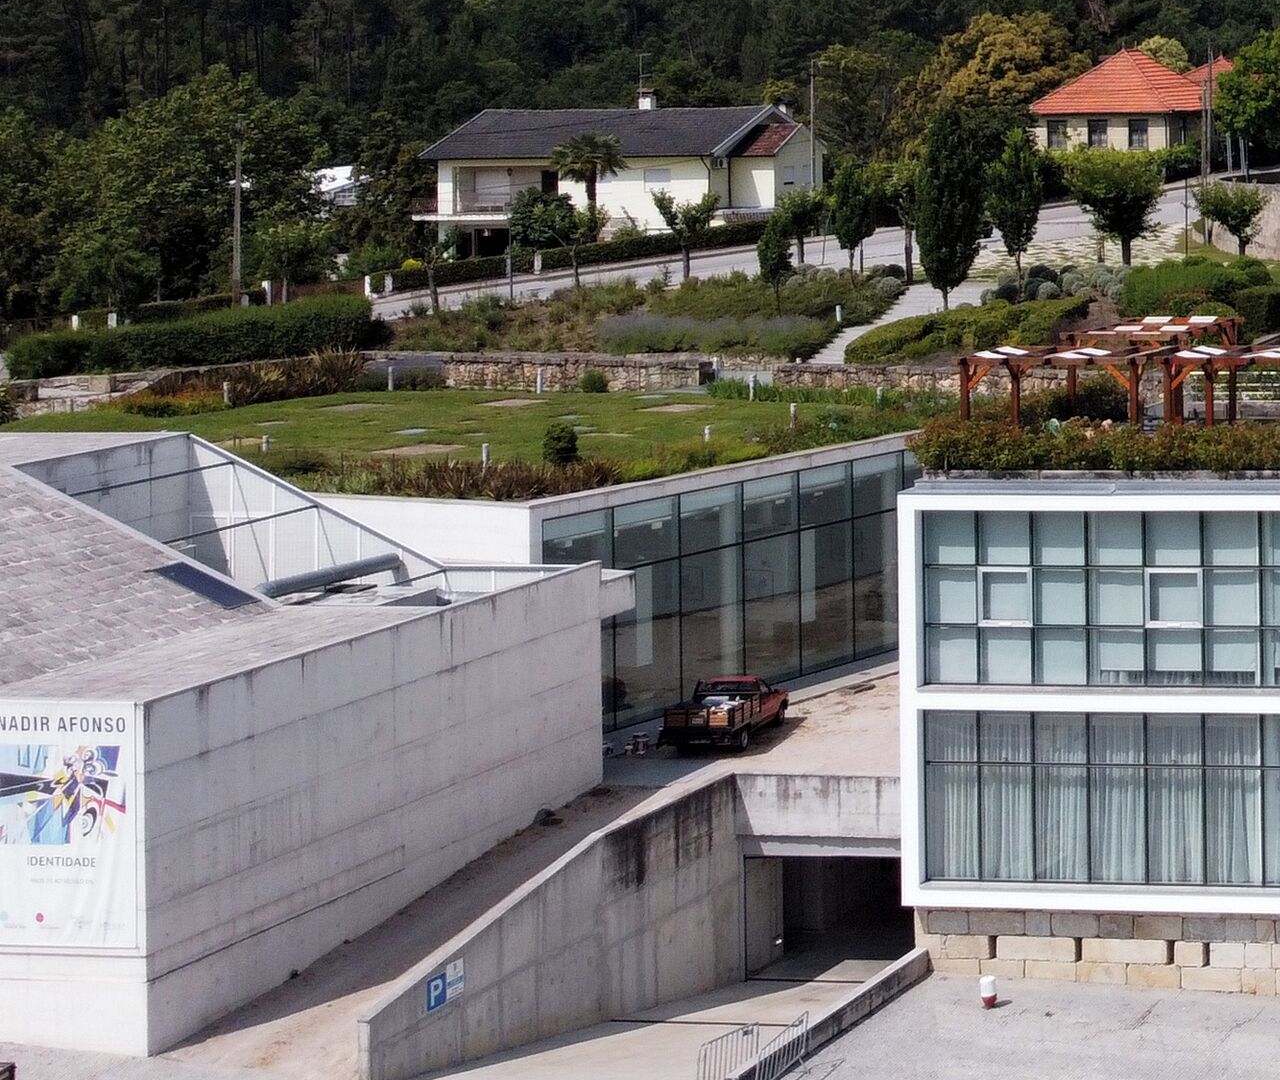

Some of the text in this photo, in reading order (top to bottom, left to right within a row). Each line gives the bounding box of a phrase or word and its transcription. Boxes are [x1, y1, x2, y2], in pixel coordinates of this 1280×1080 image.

[0, 716, 126, 732] NADIR AFONSO
[26, 856, 97, 868] IDENTIDADE
[430, 978, 443, 1007] P
